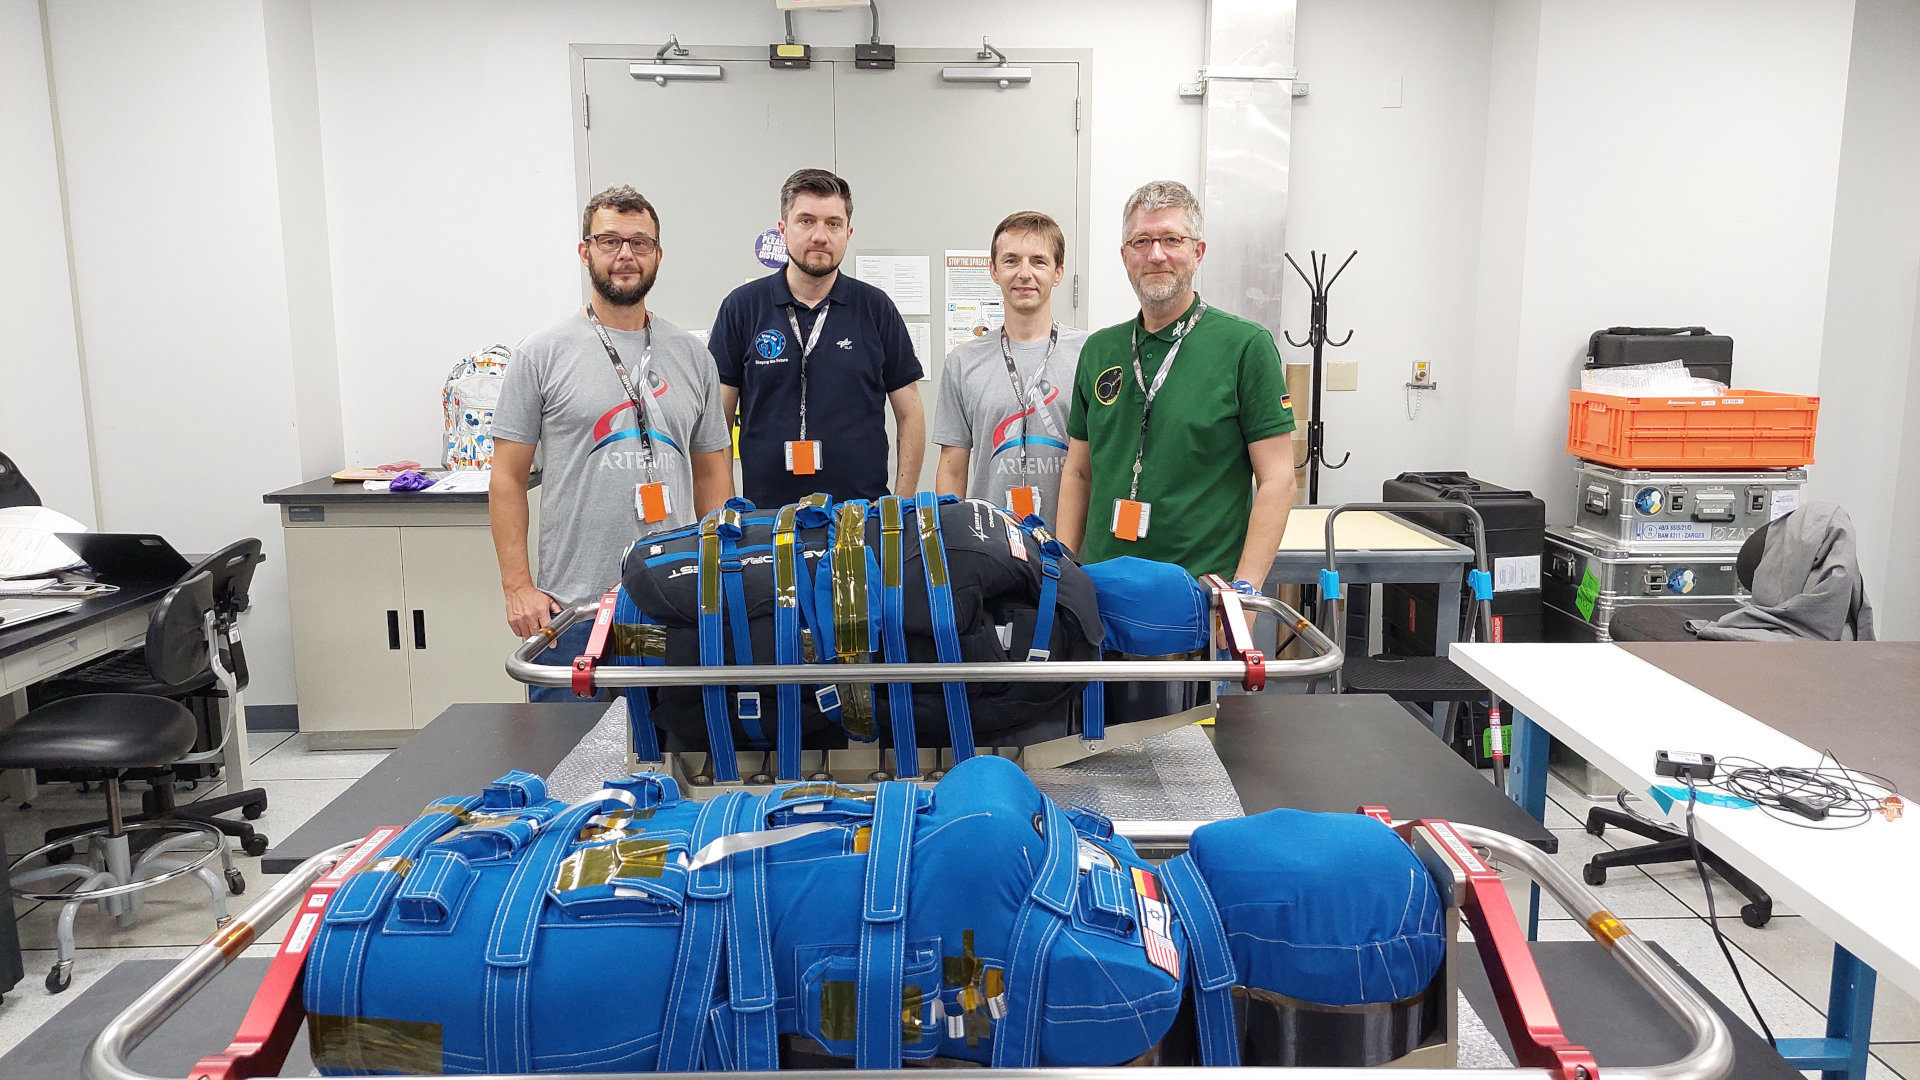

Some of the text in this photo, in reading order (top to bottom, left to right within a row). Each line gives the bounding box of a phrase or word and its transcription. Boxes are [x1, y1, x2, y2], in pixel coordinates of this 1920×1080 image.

[762, 235, 786, 246] PLEAS
[762, 243, 787, 254] DO NOT
[948, 257, 960, 266] STOP
[961, 257, 969, 266] THE
[969, 257, 987, 266] SPREAD
